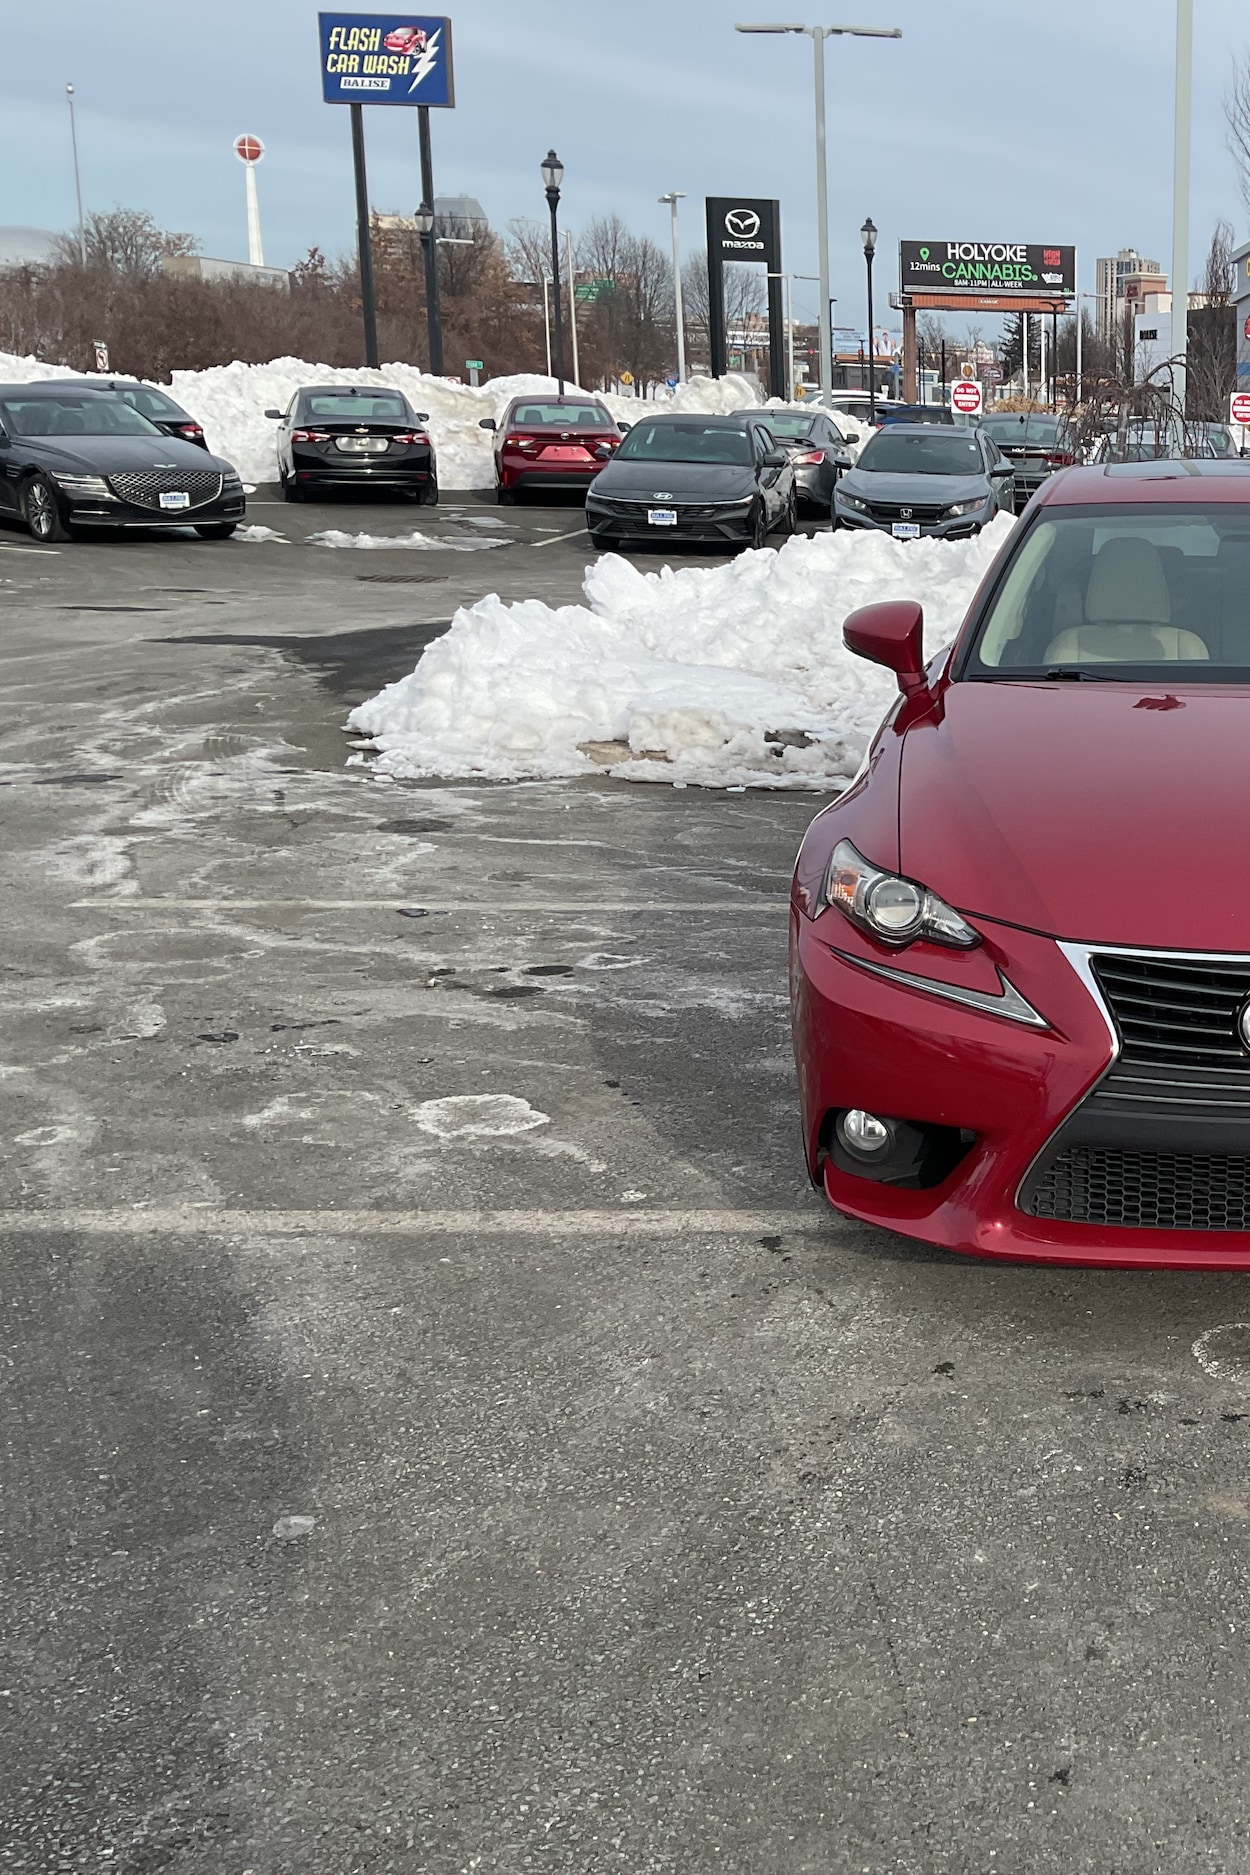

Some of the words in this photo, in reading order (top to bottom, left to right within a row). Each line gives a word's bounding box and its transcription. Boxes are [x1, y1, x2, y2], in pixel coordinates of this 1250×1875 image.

[329, 26, 382, 51] FLASH
[326, 53, 359, 73] CAR
[362, 54, 410, 75] WASH
[342, 79, 388, 88] BALISE
[722, 240, 764, 250] mazda
[947, 242, 1027, 262] HOLYOKE
[910, 261, 941, 272] 12mins
